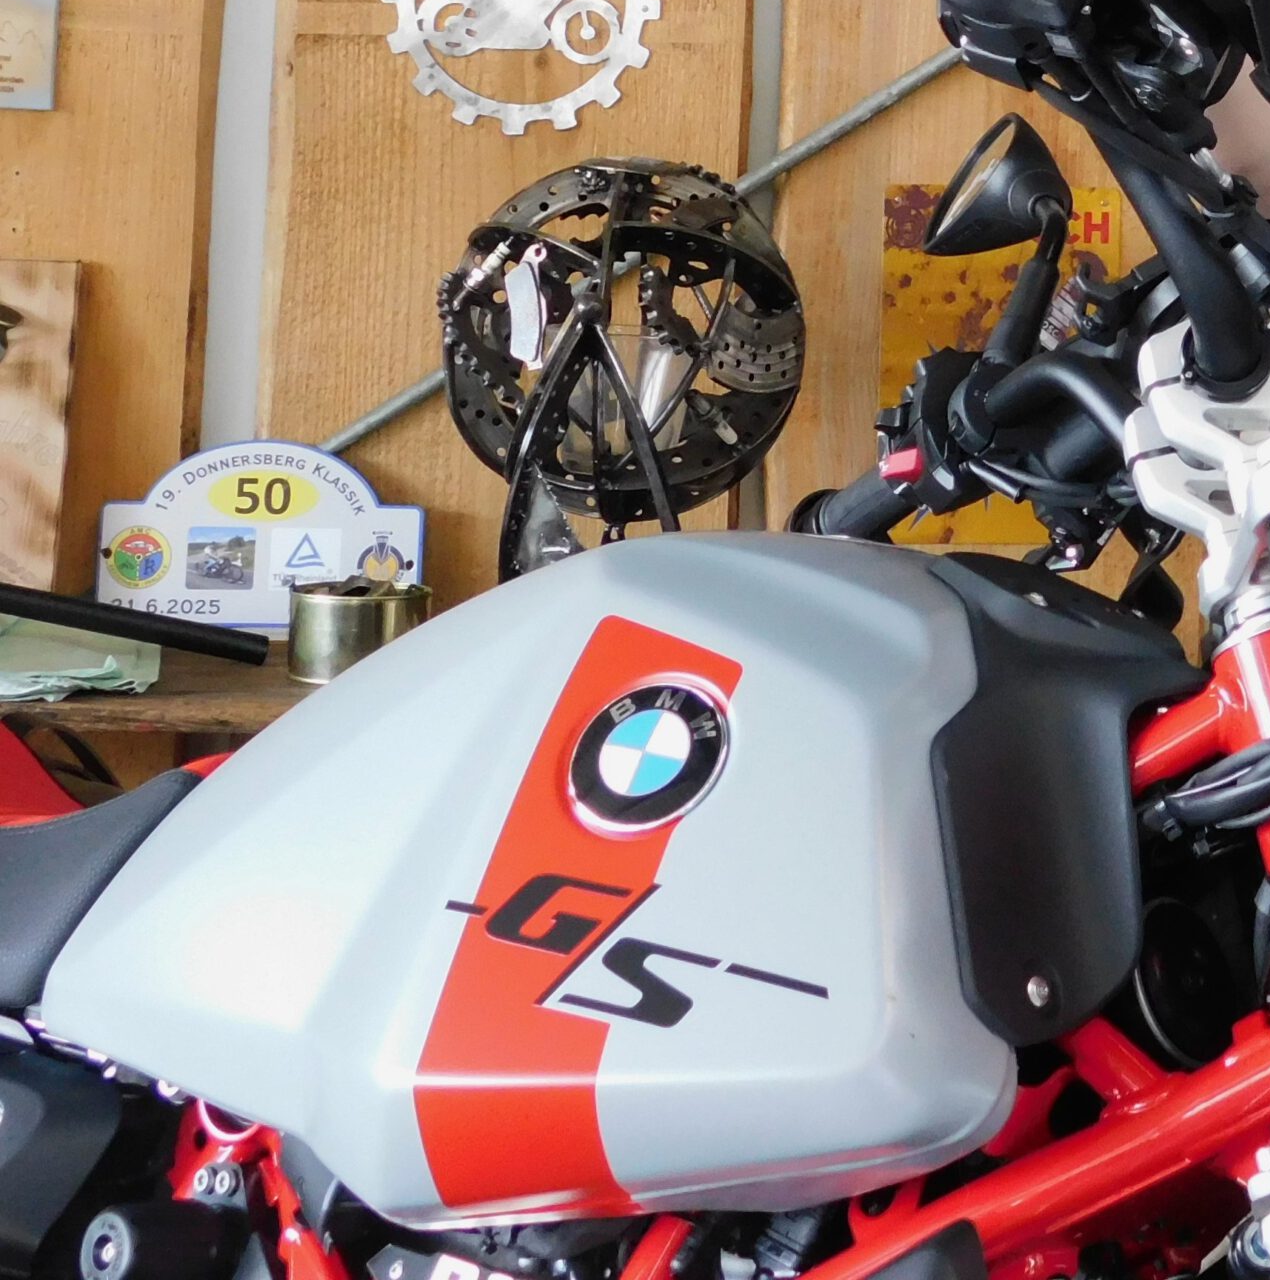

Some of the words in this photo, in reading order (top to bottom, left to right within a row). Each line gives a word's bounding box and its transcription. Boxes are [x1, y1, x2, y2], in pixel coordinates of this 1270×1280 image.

[156, 489, 181, 511] 19.
[183, 453, 306, 486] DONNERSBERG
[312, 463, 366, 517] KLASSIK
[234, 477, 291, 515] 50
[609, 688, 717, 741] BMW
